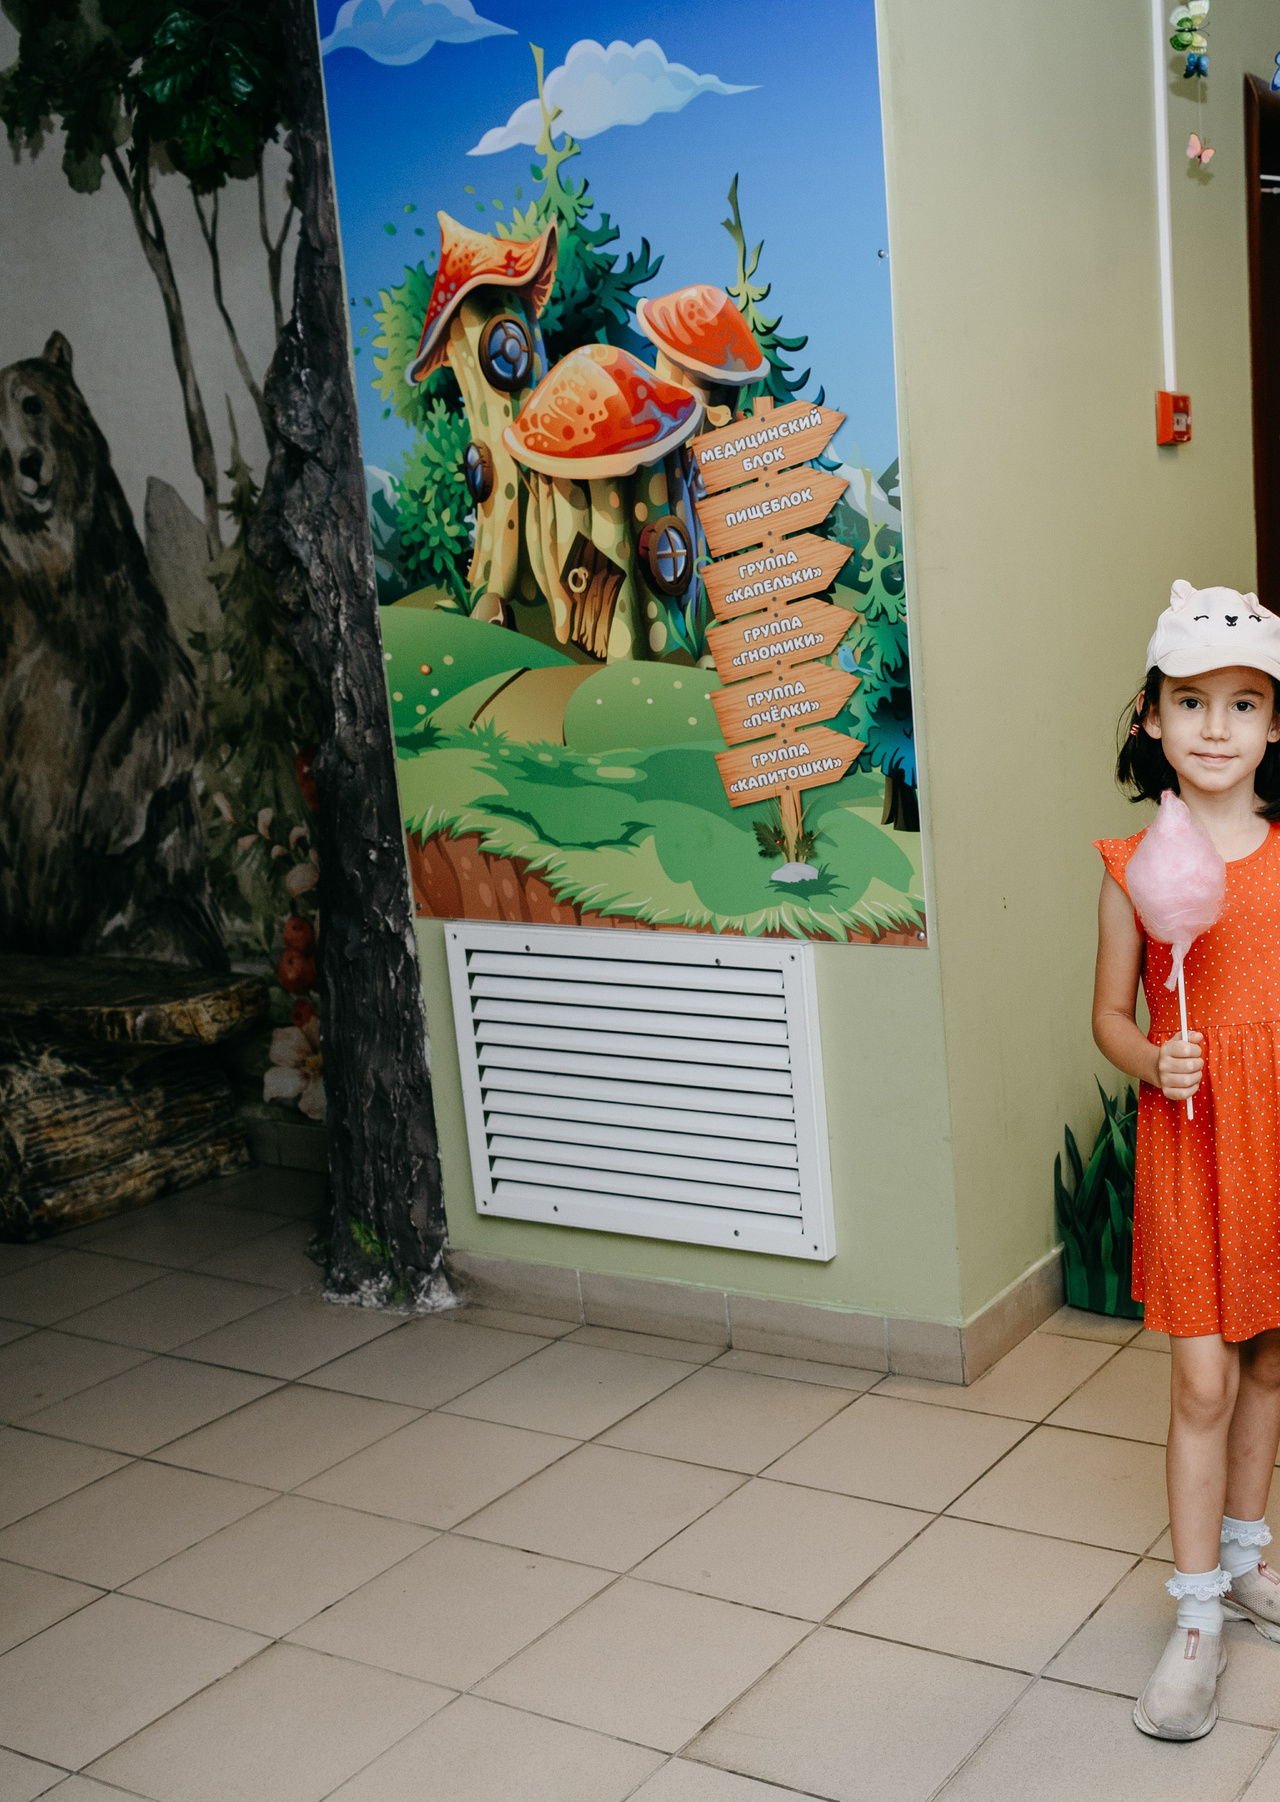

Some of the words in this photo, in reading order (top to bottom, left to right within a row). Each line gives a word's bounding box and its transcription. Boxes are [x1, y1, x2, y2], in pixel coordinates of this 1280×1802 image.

[700, 409, 823, 464] МЕДИЦИНСКИЙ
[742, 446, 786, 472] БЛОК
[725, 488, 814, 527] ПИЩЕБЛОК
[738, 551, 799, 579] ГРУППА
[724, 566, 823, 605] «КАПЕЛЬКИ»
[743, 616, 803, 643] ГРУППА
[731, 632, 825, 668] «ГНОМИКИ»
[746, 681, 806, 708] ГРУППА
[742, 698, 821, 730] «ПЧЁЛКИ»
[751, 742, 811, 769] ГРУППА
[729, 756, 843, 794] «КАПИТОШКИ»
